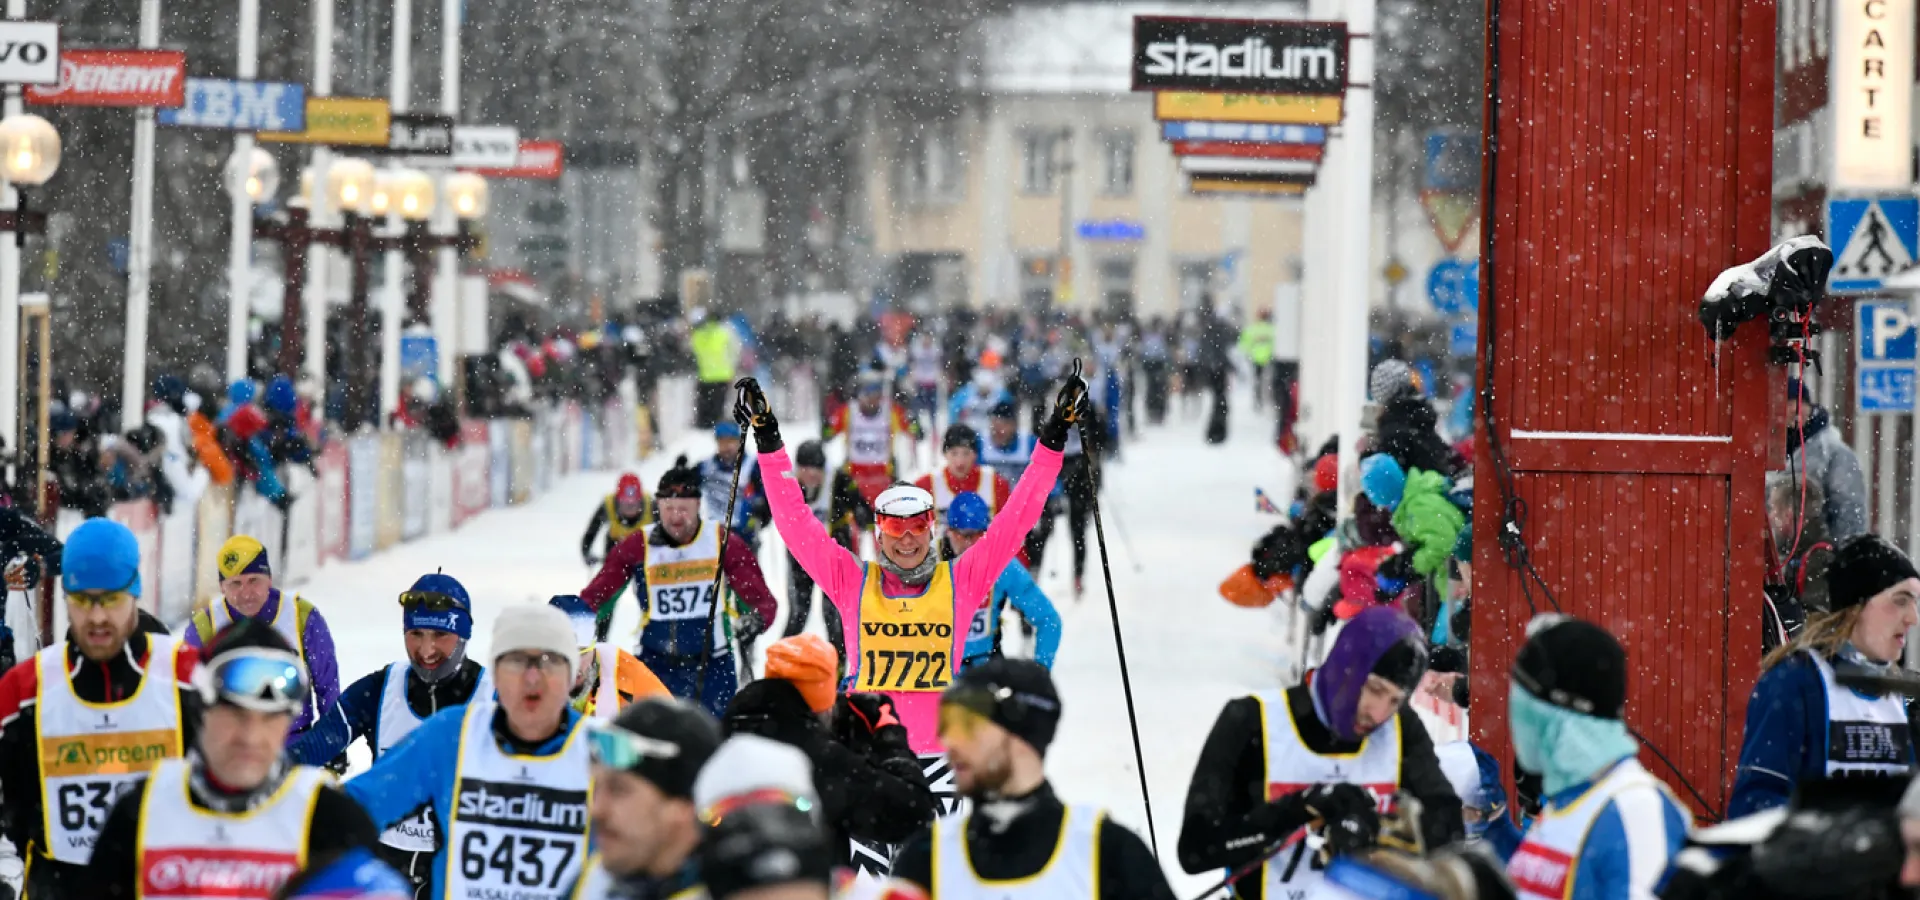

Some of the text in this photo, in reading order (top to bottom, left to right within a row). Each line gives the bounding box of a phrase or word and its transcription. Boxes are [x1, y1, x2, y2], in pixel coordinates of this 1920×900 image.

[1144, 35, 1335, 80] stadium
[1863, 0, 1885, 138] CARTE
[174, 76, 285, 130] IBM
[1873, 308, 1909, 357] P
[656, 584, 717, 615] 6374
[861, 621, 951, 638] VOLVO
[865, 650, 948, 689] 17722
[94, 743, 166, 765] preem
[1844, 725, 1897, 760] IBM
[458, 786, 588, 828] stadium
[461, 830, 577, 889] 6437
